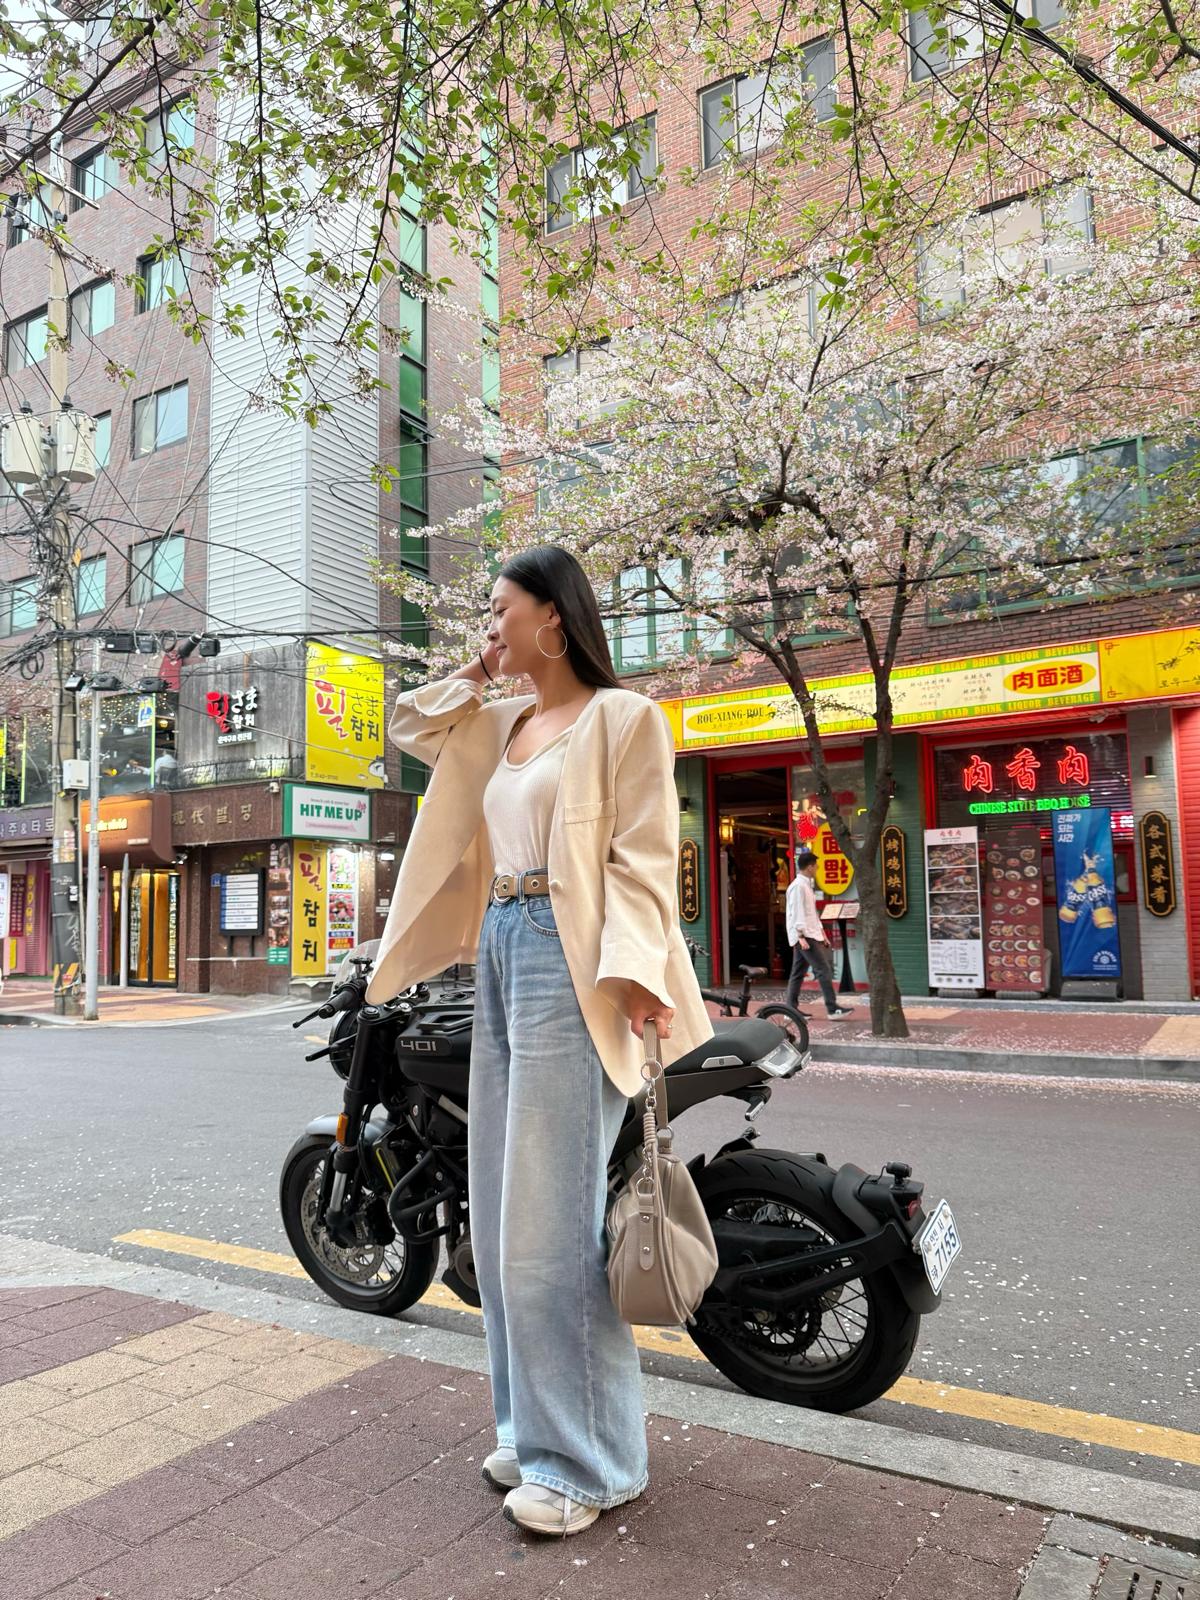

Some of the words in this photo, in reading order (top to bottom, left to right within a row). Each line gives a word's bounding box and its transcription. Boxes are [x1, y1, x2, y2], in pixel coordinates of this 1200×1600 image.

[940, 659, 967, 672] SALAD
[973, 655, 998, 668] DRINK
[1006, 649, 1039, 663] LIQUOR
[1045, 643, 1092, 656] BEVERAGE
[1012, 664, 1083, 690] 肉面酒
[900, 711, 936, 724] STIR-FRY
[942, 708, 968, 720] SALAD
[974, 703, 1000, 715] DRINK
[1008, 700, 1041, 712] LIQUOR
[1047, 694, 1094, 706] BEVERAGE
[350, 715, 379, 741] 참치
[964, 745, 1090, 793] 肉香肉
[300, 803, 322, 817] HIT
[324, 806, 343, 819] ME
[345, 809, 362, 821] UP
[969, 801, 1007, 815] CHINESE
[1007, 800, 1035, 813] STYLE
[1036, 798, 1059, 811] BBQ
[1059, 795, 1091, 809] HOUSE
[1057, 823, 1074, 833] 되는
[1057, 833, 1074, 843] 시간
[302, 898, 320, 962] 참치
[400, 1040, 437, 1051] 401
[935, 1224, 957, 1272] 7155
